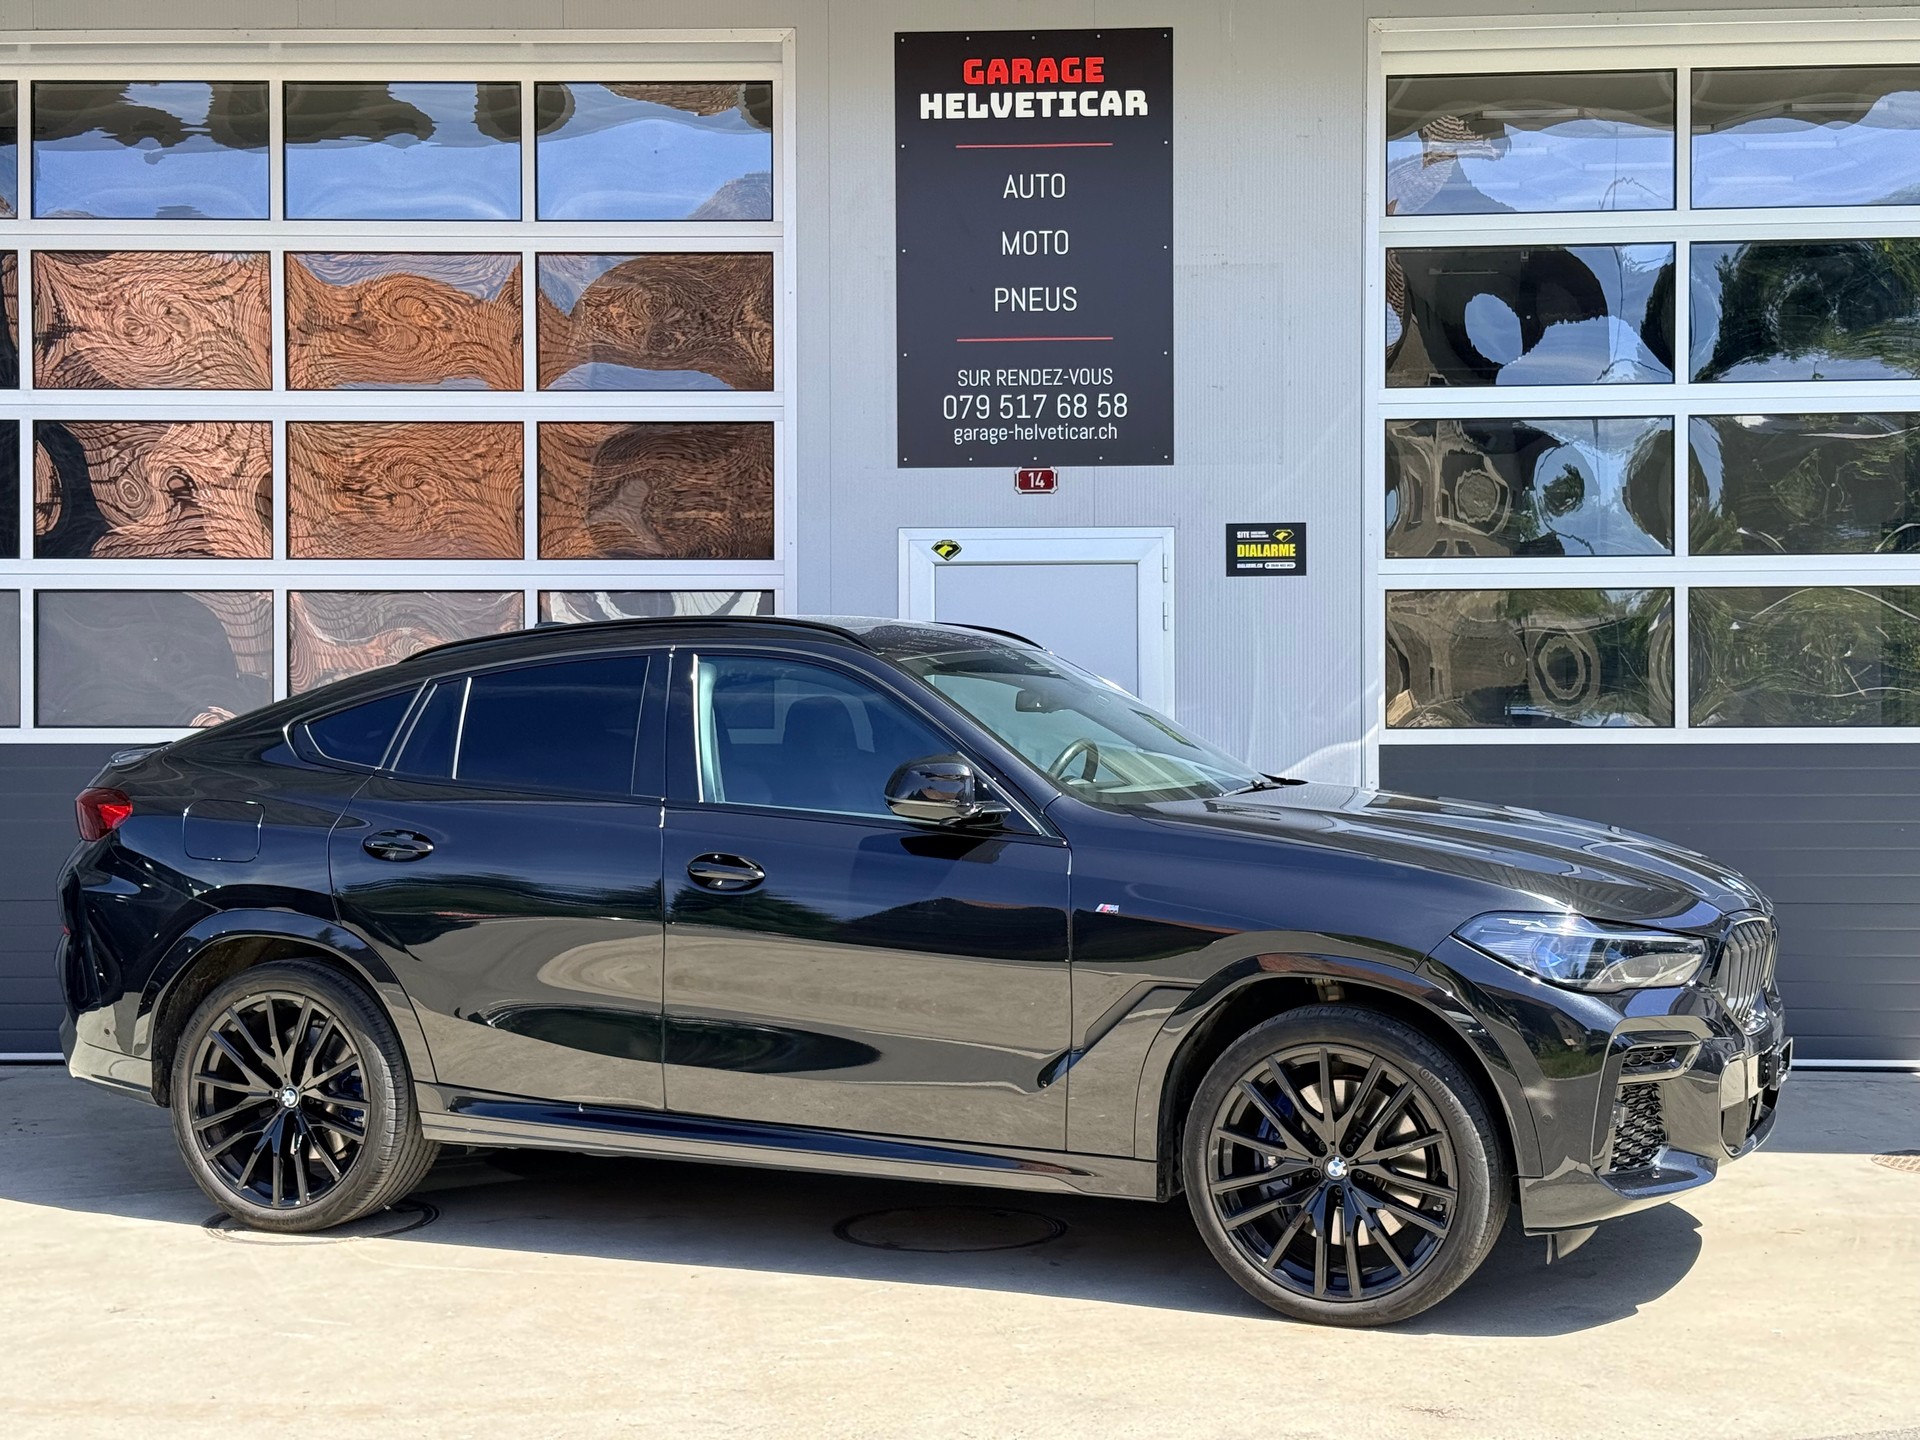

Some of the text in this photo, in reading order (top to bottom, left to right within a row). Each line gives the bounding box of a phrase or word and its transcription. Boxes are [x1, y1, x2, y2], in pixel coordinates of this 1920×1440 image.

[963, 57, 1105, 85] GARAGE
[920, 90, 1148, 119] HELVETICAR
[1003, 173, 1066, 199] AUTO
[1001, 230, 1069, 256] MOTO
[994, 286, 1078, 312] PNEUS
[957, 368, 1114, 387] SUR RENDEZ-VOUS
[943, 393, 1128, 420] 079 517 68 58
[953, 423, 1118, 445] garage-helveticar.ch
[1028, 472, 1045, 488] 14
[1236, 543, 1296, 557] DIALARME
